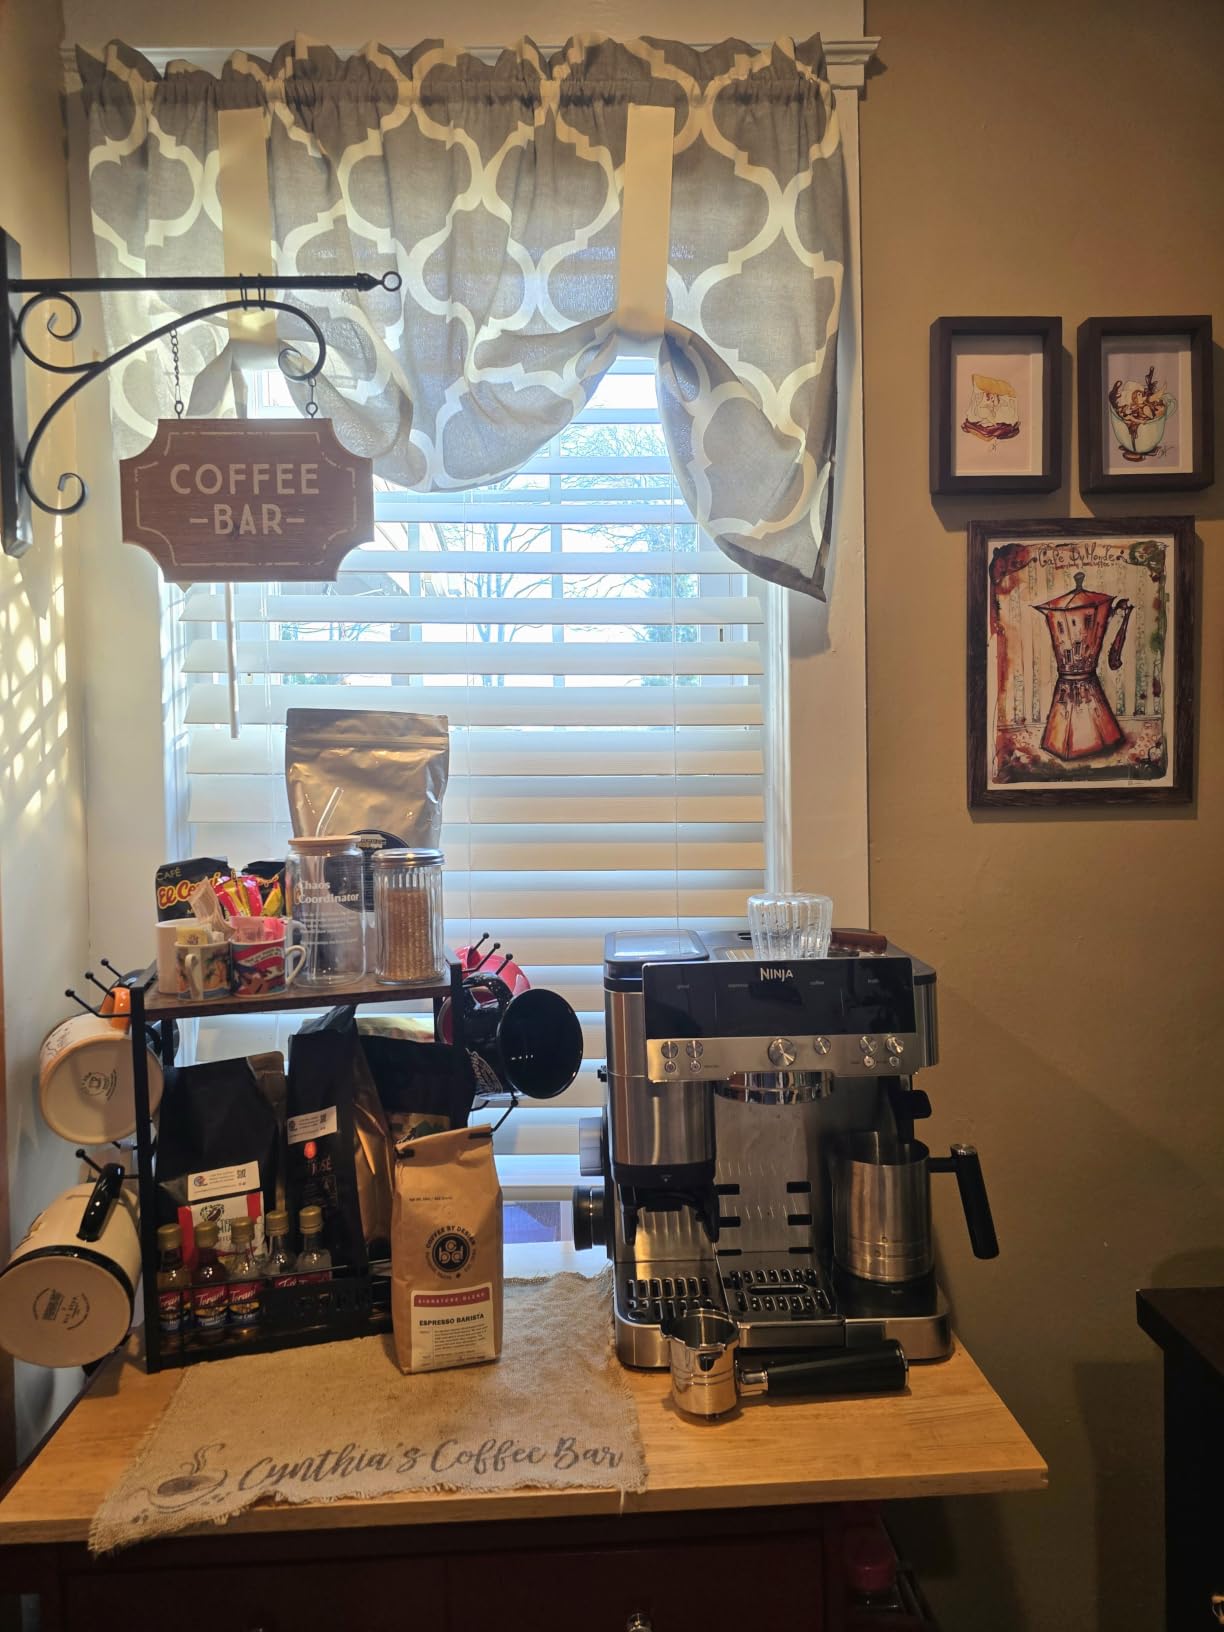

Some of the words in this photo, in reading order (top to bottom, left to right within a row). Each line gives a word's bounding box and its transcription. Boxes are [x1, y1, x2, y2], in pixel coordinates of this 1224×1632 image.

[170, 463, 320, 495] COFFEE
[157, 867, 182, 881] CAFÉ
[299, 880, 331, 890] Chaos
[158, 885, 178, 909] El
[299, 893, 360, 904] Coordinator
[759, 967, 794, 982] NINJA
[425, 1226, 445, 1249] COFFEE
[419, 1317, 455, 1327] ESPRESSO
[456, 1312, 485, 1324] BARISTA
[238, 1441, 424, 1492] Cynthia's
[431, 1438, 545, 1475] Coffee
[554, 1437, 624, 1471] Bar
